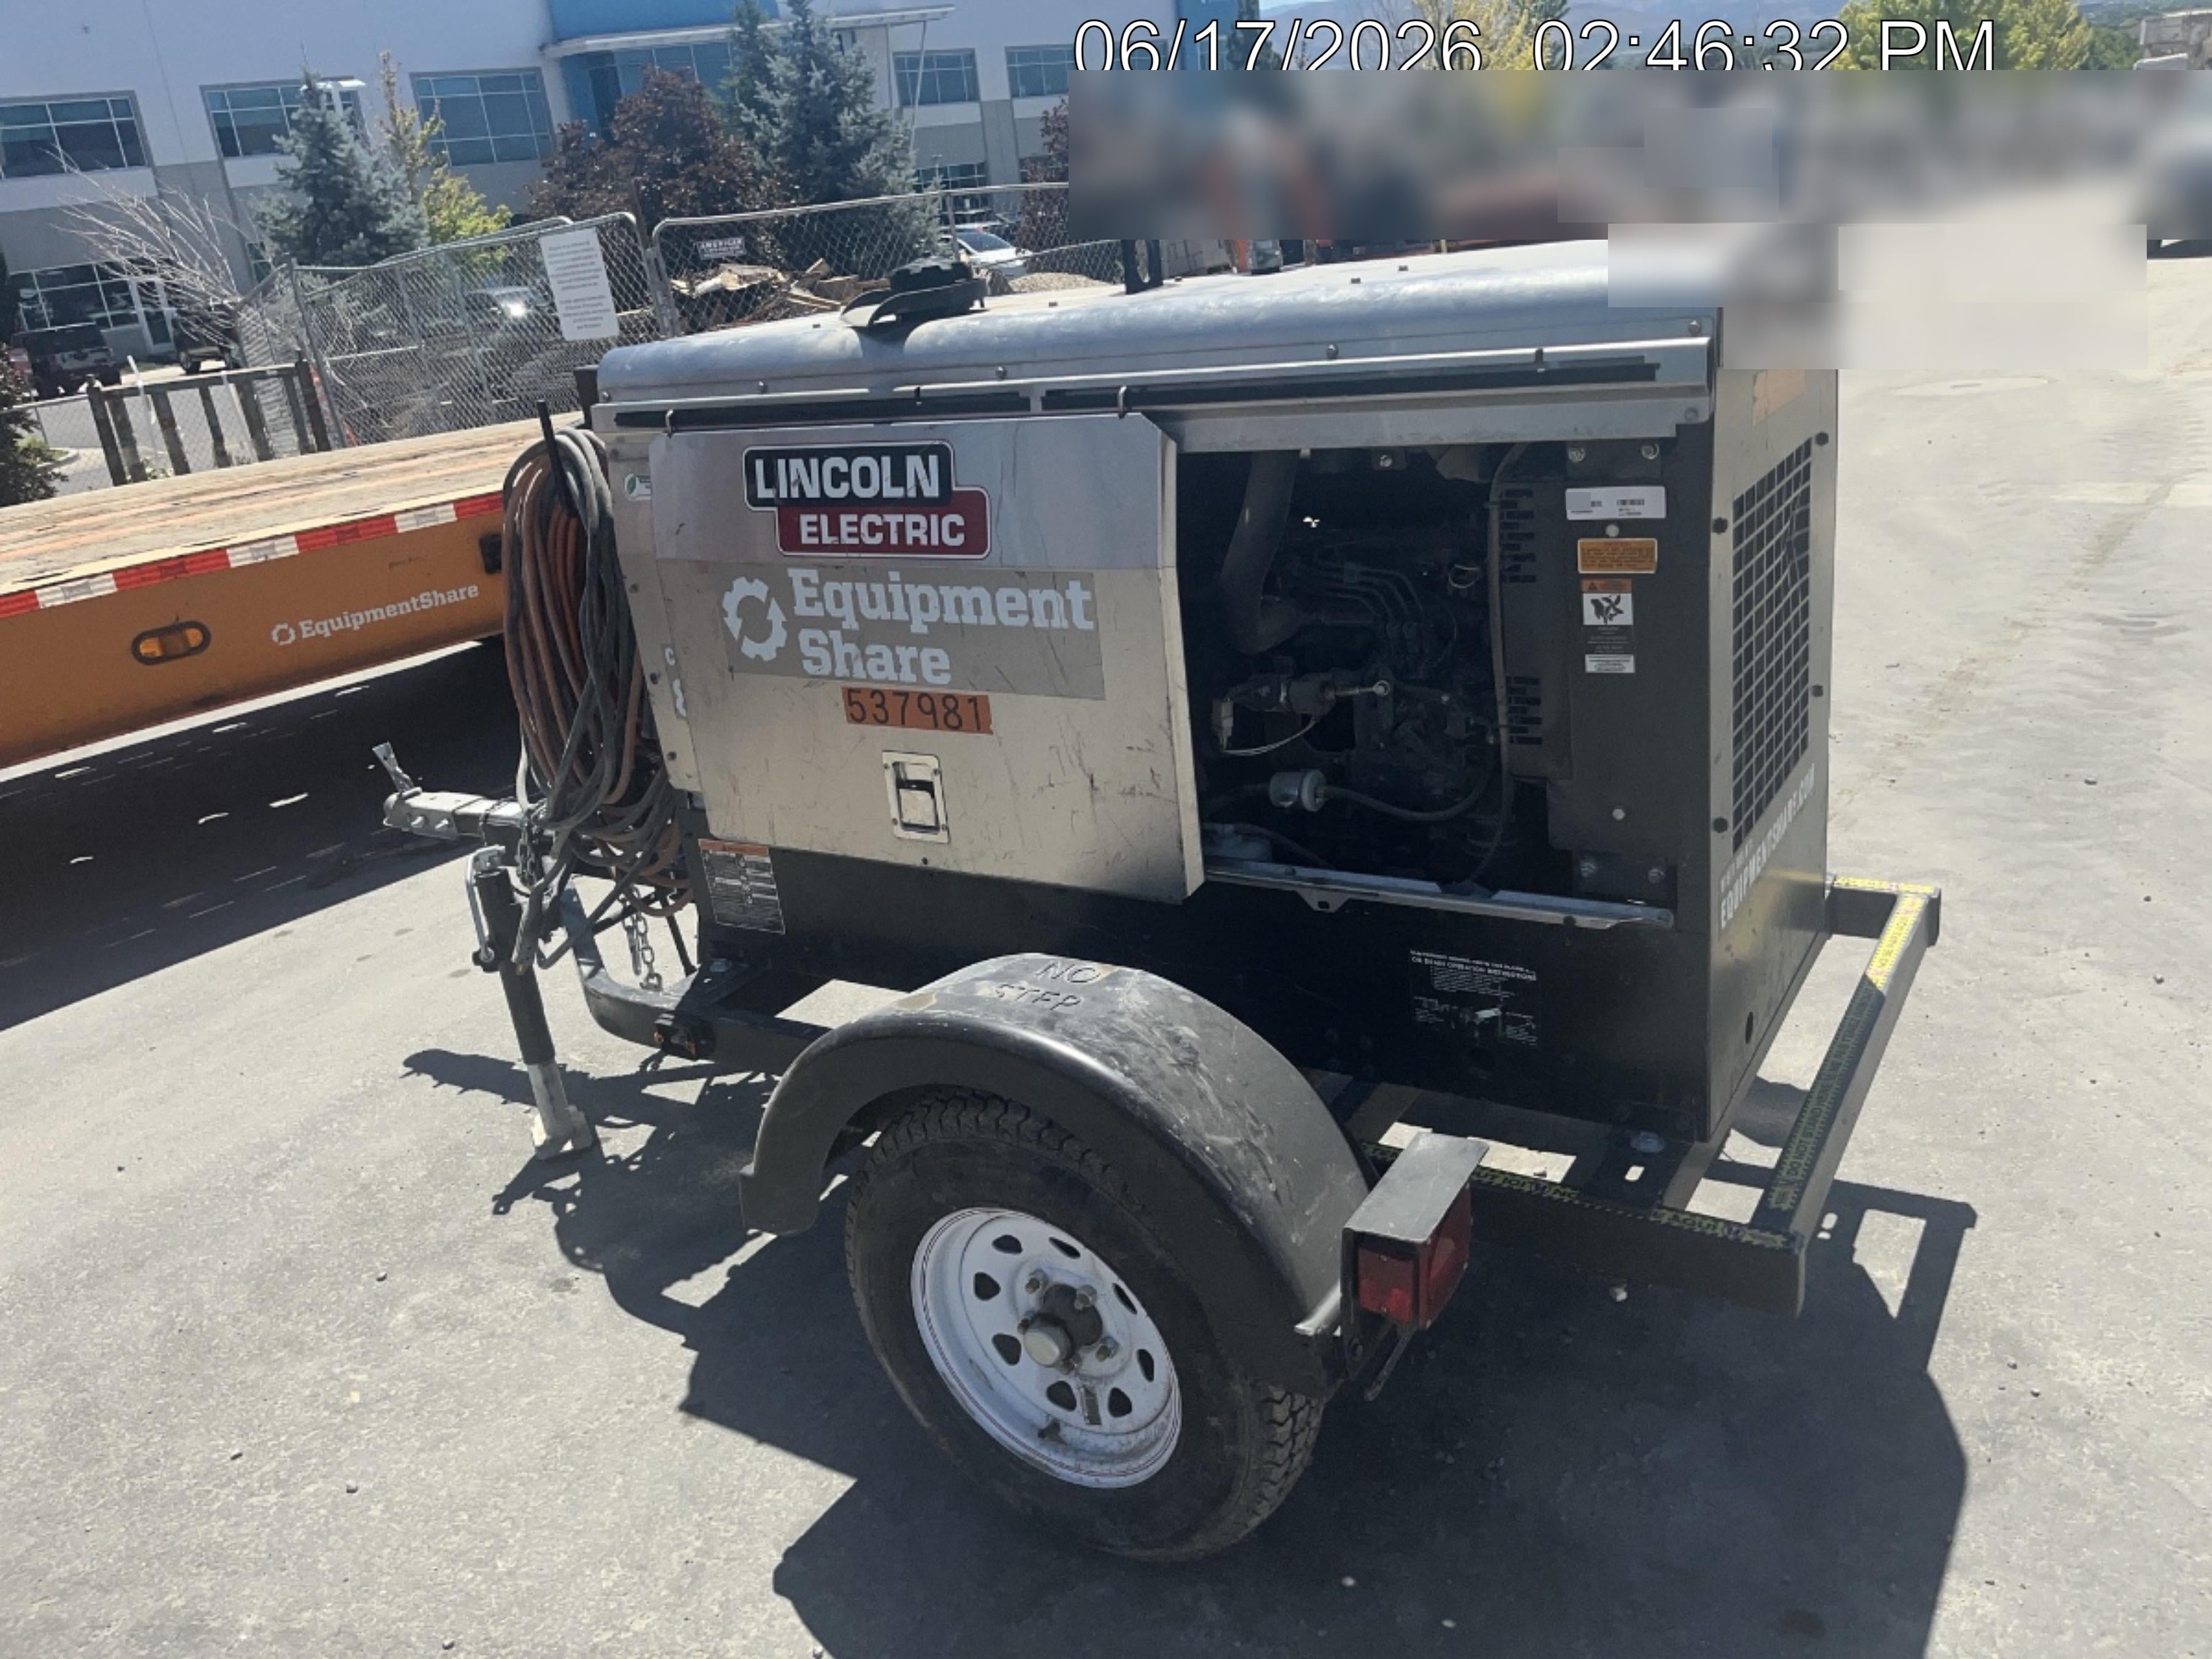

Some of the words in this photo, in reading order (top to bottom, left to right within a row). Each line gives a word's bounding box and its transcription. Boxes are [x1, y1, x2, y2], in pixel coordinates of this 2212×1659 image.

[754, 453, 940, 499] LINCOLN
[800, 512, 966, 547] ELECTRIC
[298, 584, 480, 638] EquipmentShare
[786, 568, 1094, 633] Equipment
[797, 628, 952, 685] Share
[847, 688, 983, 731] 537981
[1035, 959, 1102, 984] NO
